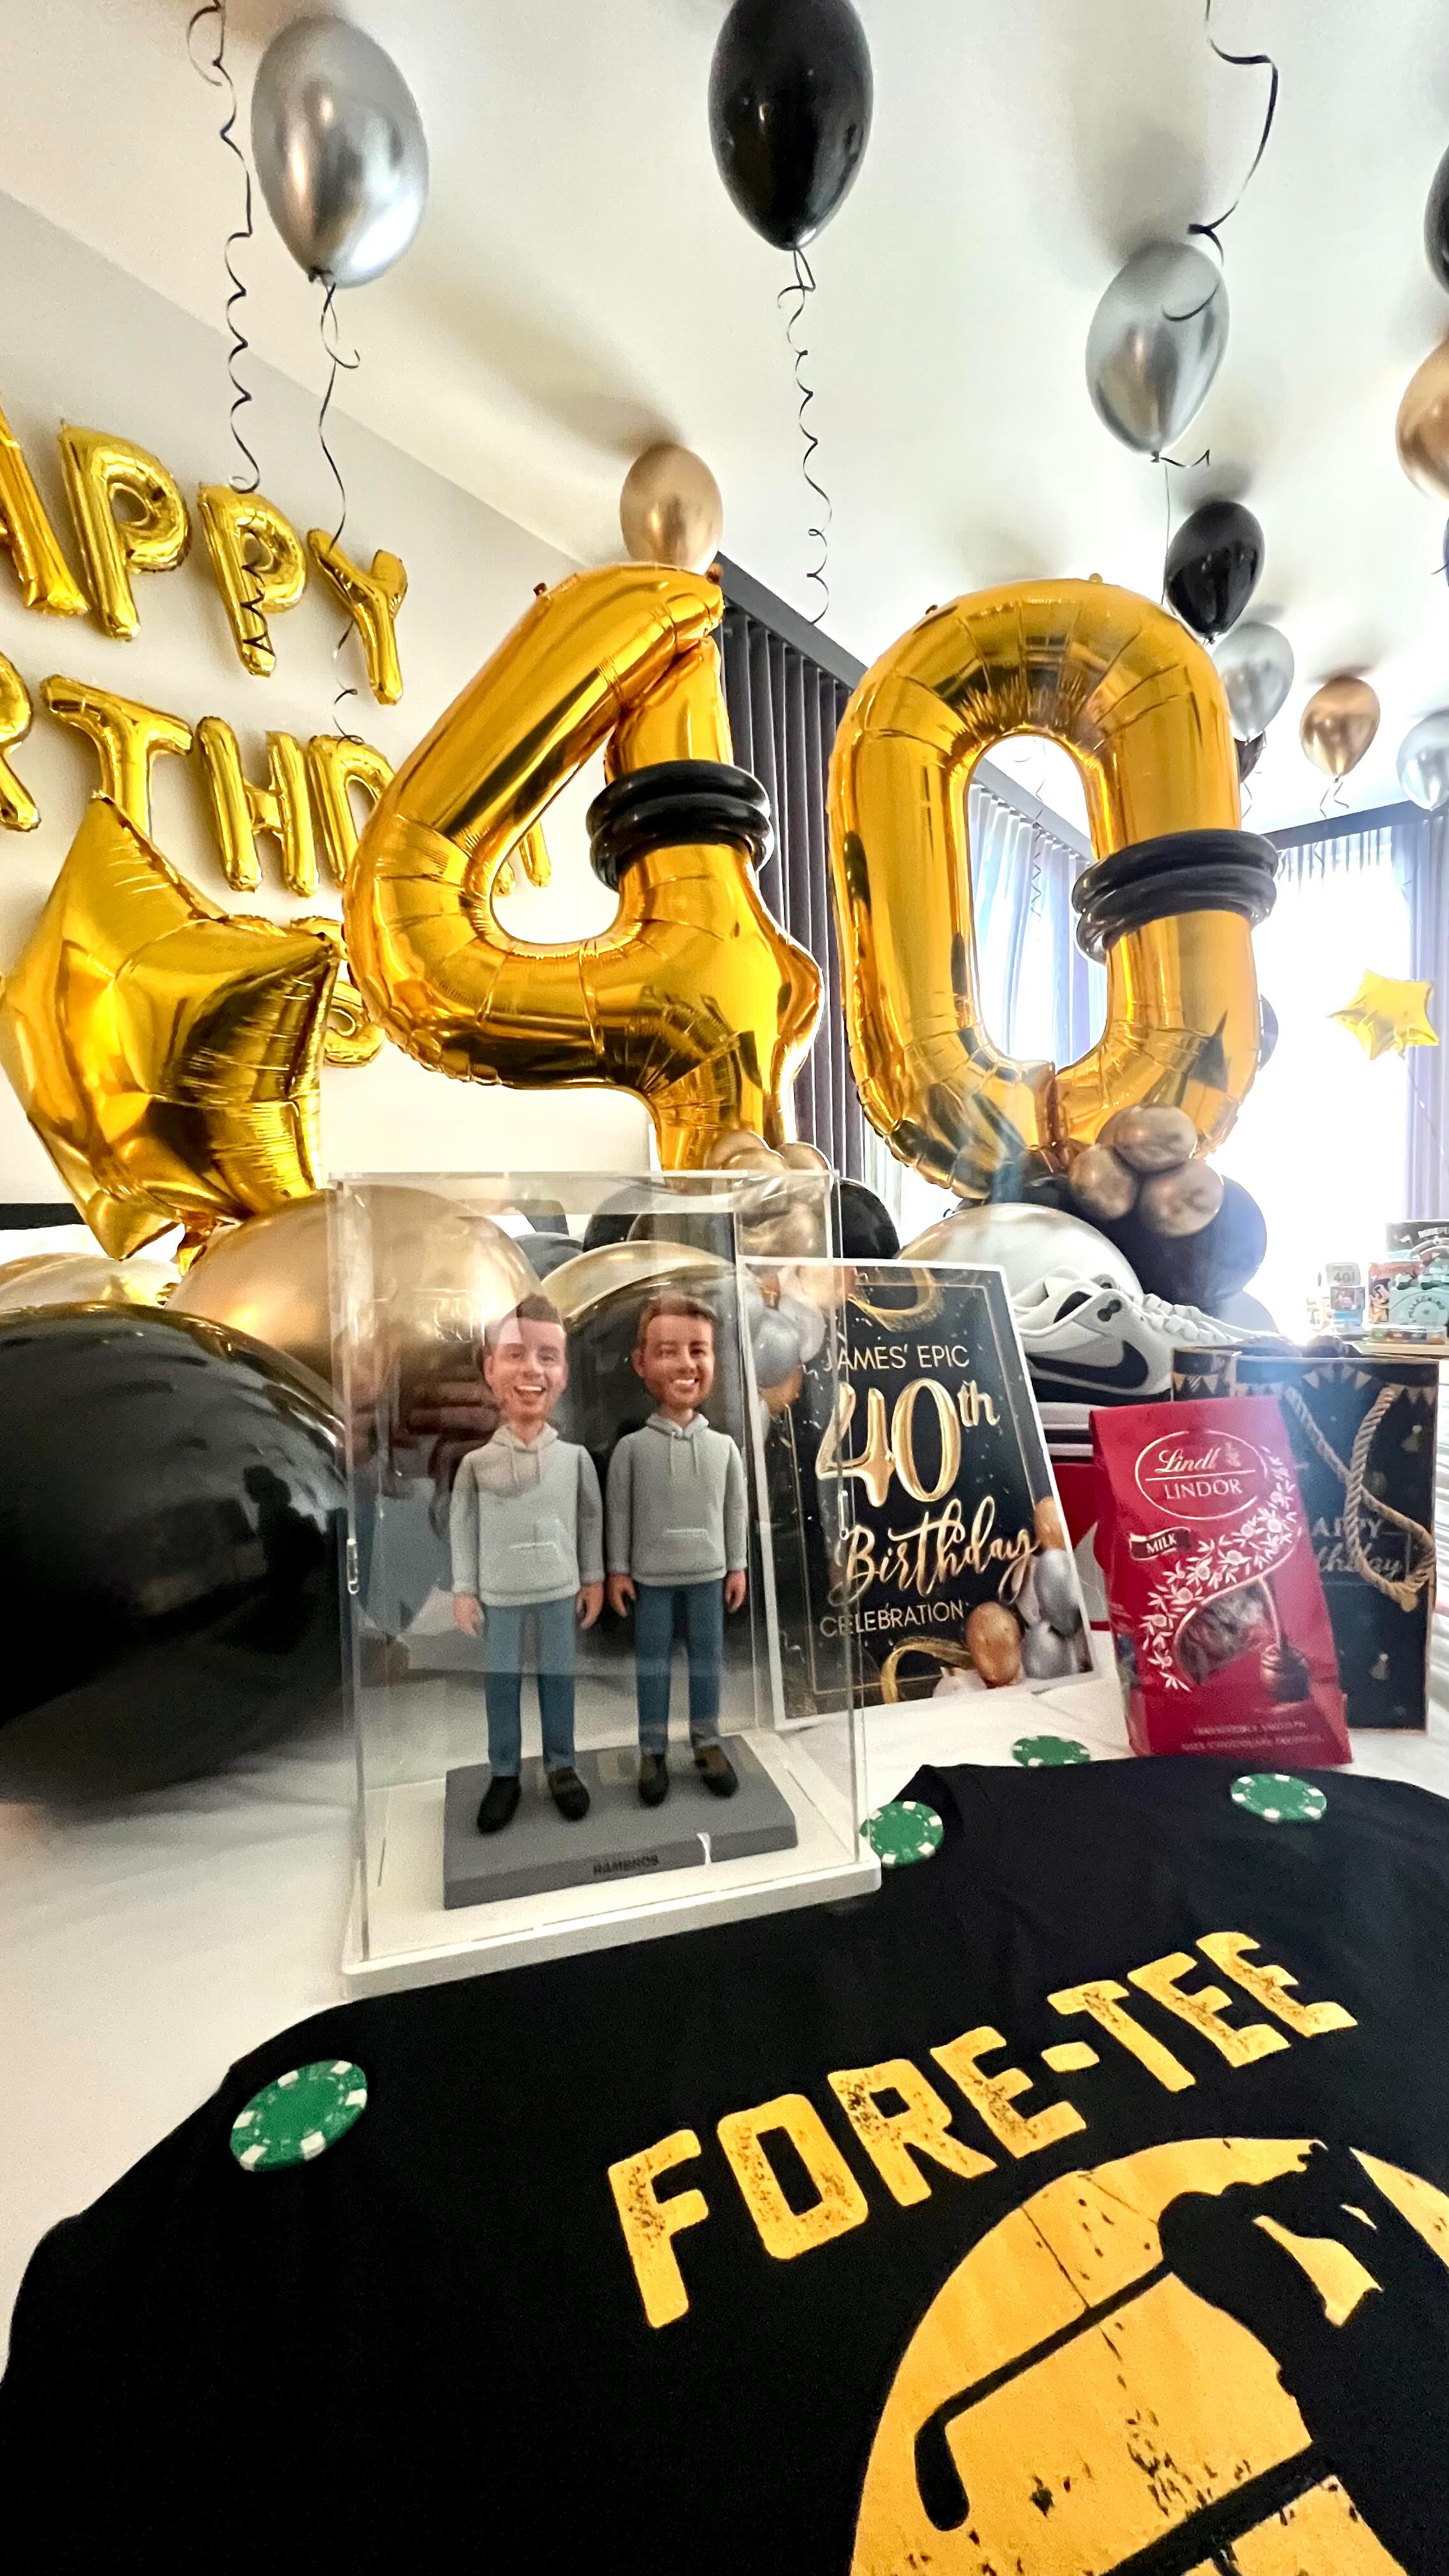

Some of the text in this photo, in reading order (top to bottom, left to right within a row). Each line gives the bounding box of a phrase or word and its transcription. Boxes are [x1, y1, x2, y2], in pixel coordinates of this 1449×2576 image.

[342, 561, 1260, 1199] 40
[824, 1344, 970, 1371] JAMES' EPIC
[1154, 1446, 1221, 1473] Lindt
[1164, 1478, 1243, 1499] LINDOR
[829, 1496, 1039, 1606] Birthday
[1146, 1533, 1177, 1554] MILK
[820, 1599, 965, 1637] CELEBRATION
[608, 1931, 1358, 2329] FORE-TEE
